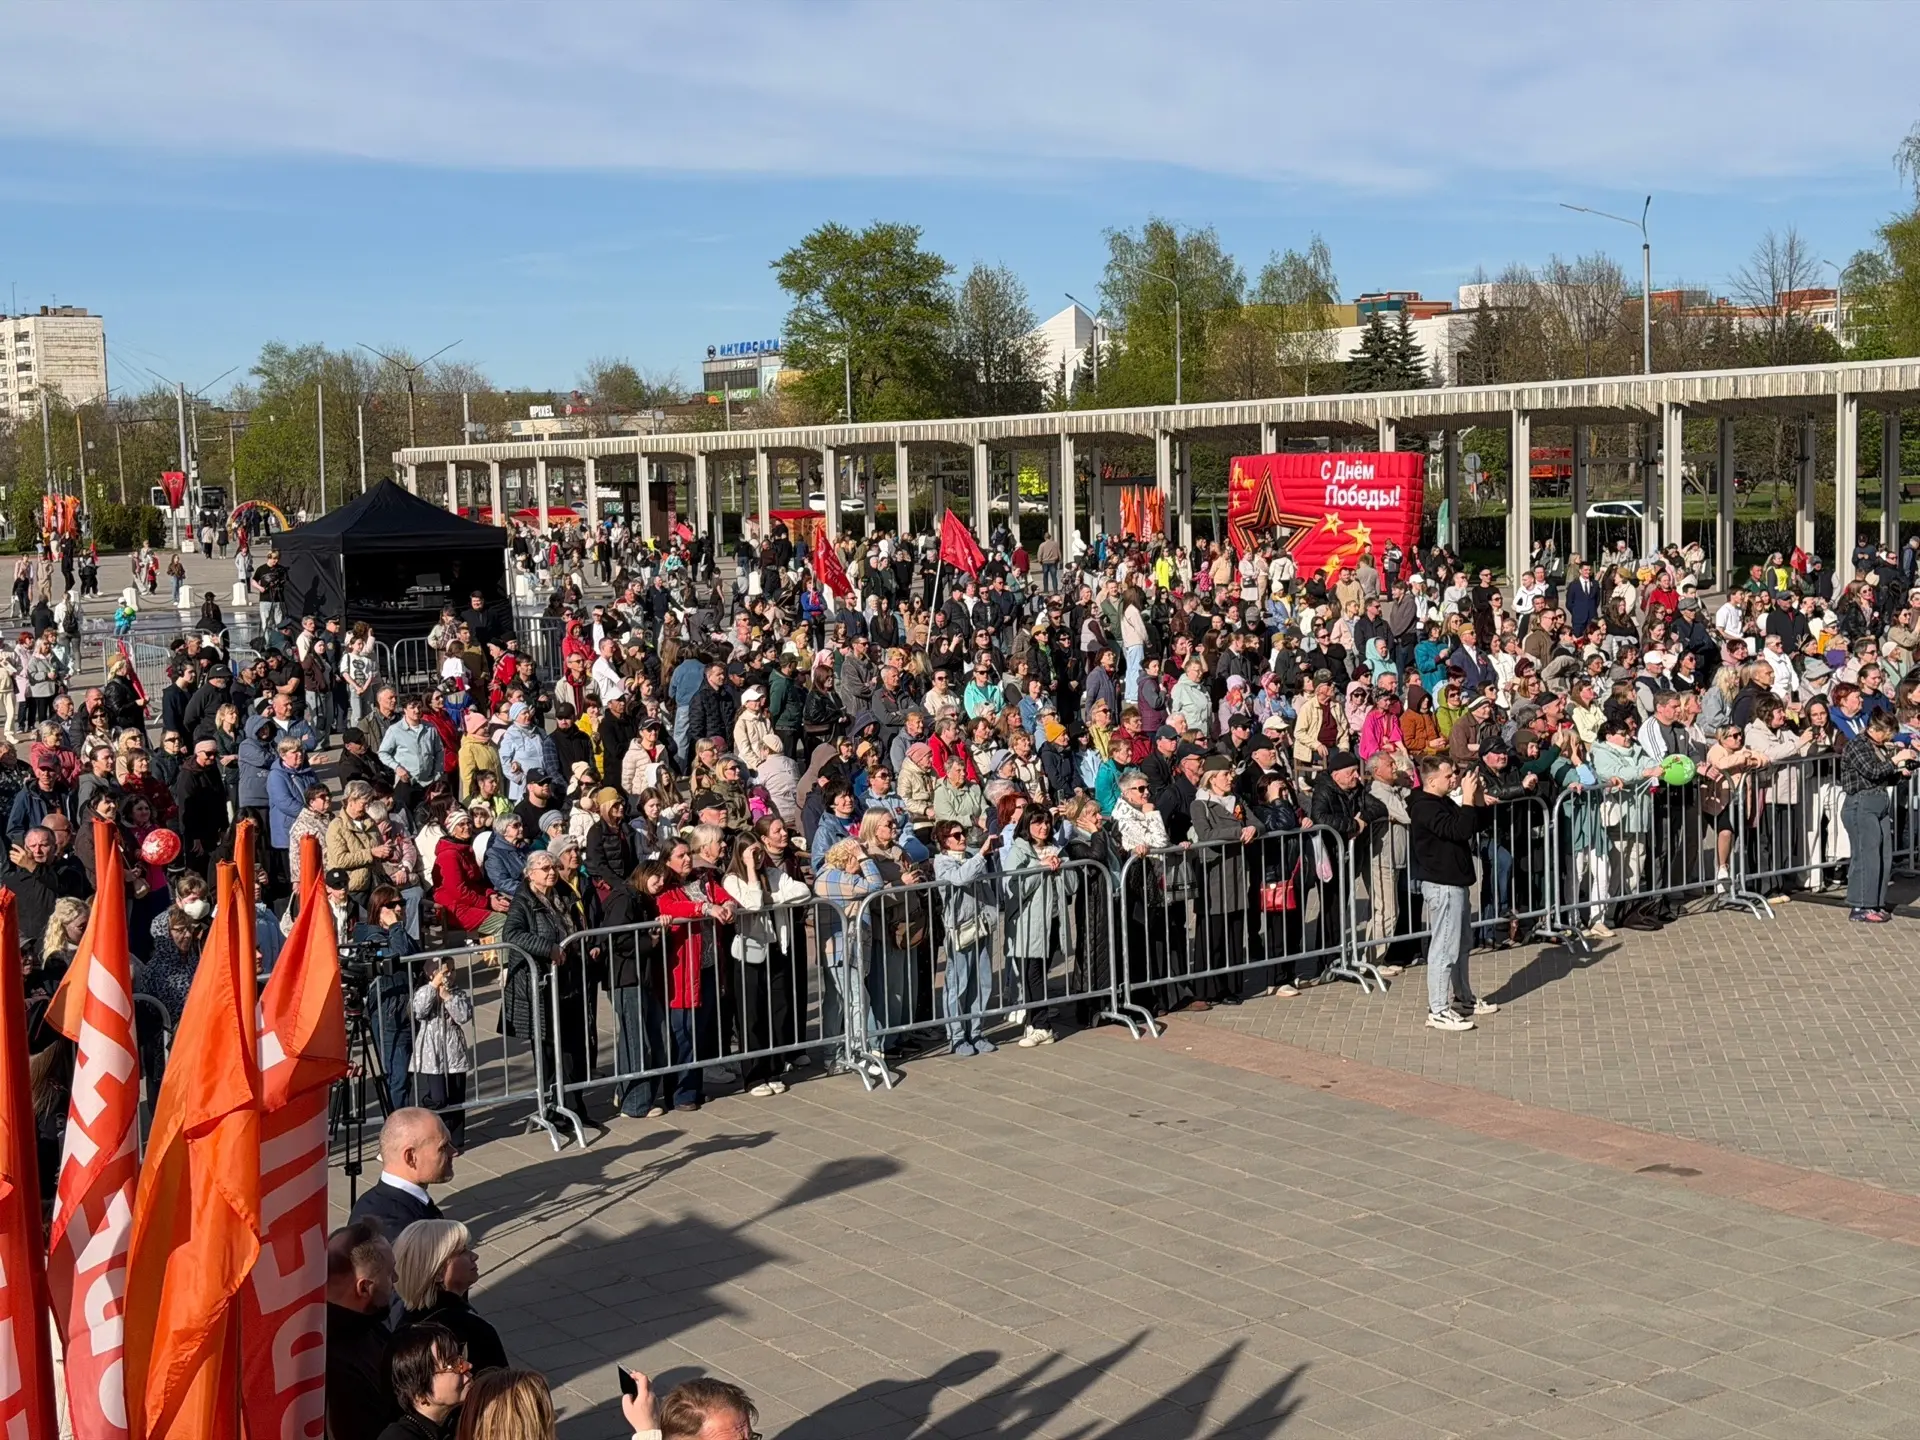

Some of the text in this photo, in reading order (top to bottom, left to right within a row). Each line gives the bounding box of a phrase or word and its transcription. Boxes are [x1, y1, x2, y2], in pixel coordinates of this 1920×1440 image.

[720, 338, 780, 356] ИНТЕРСИТИ
[1320, 460, 1375, 484] С Днём
[1325, 483, 1400, 511] Победы!
